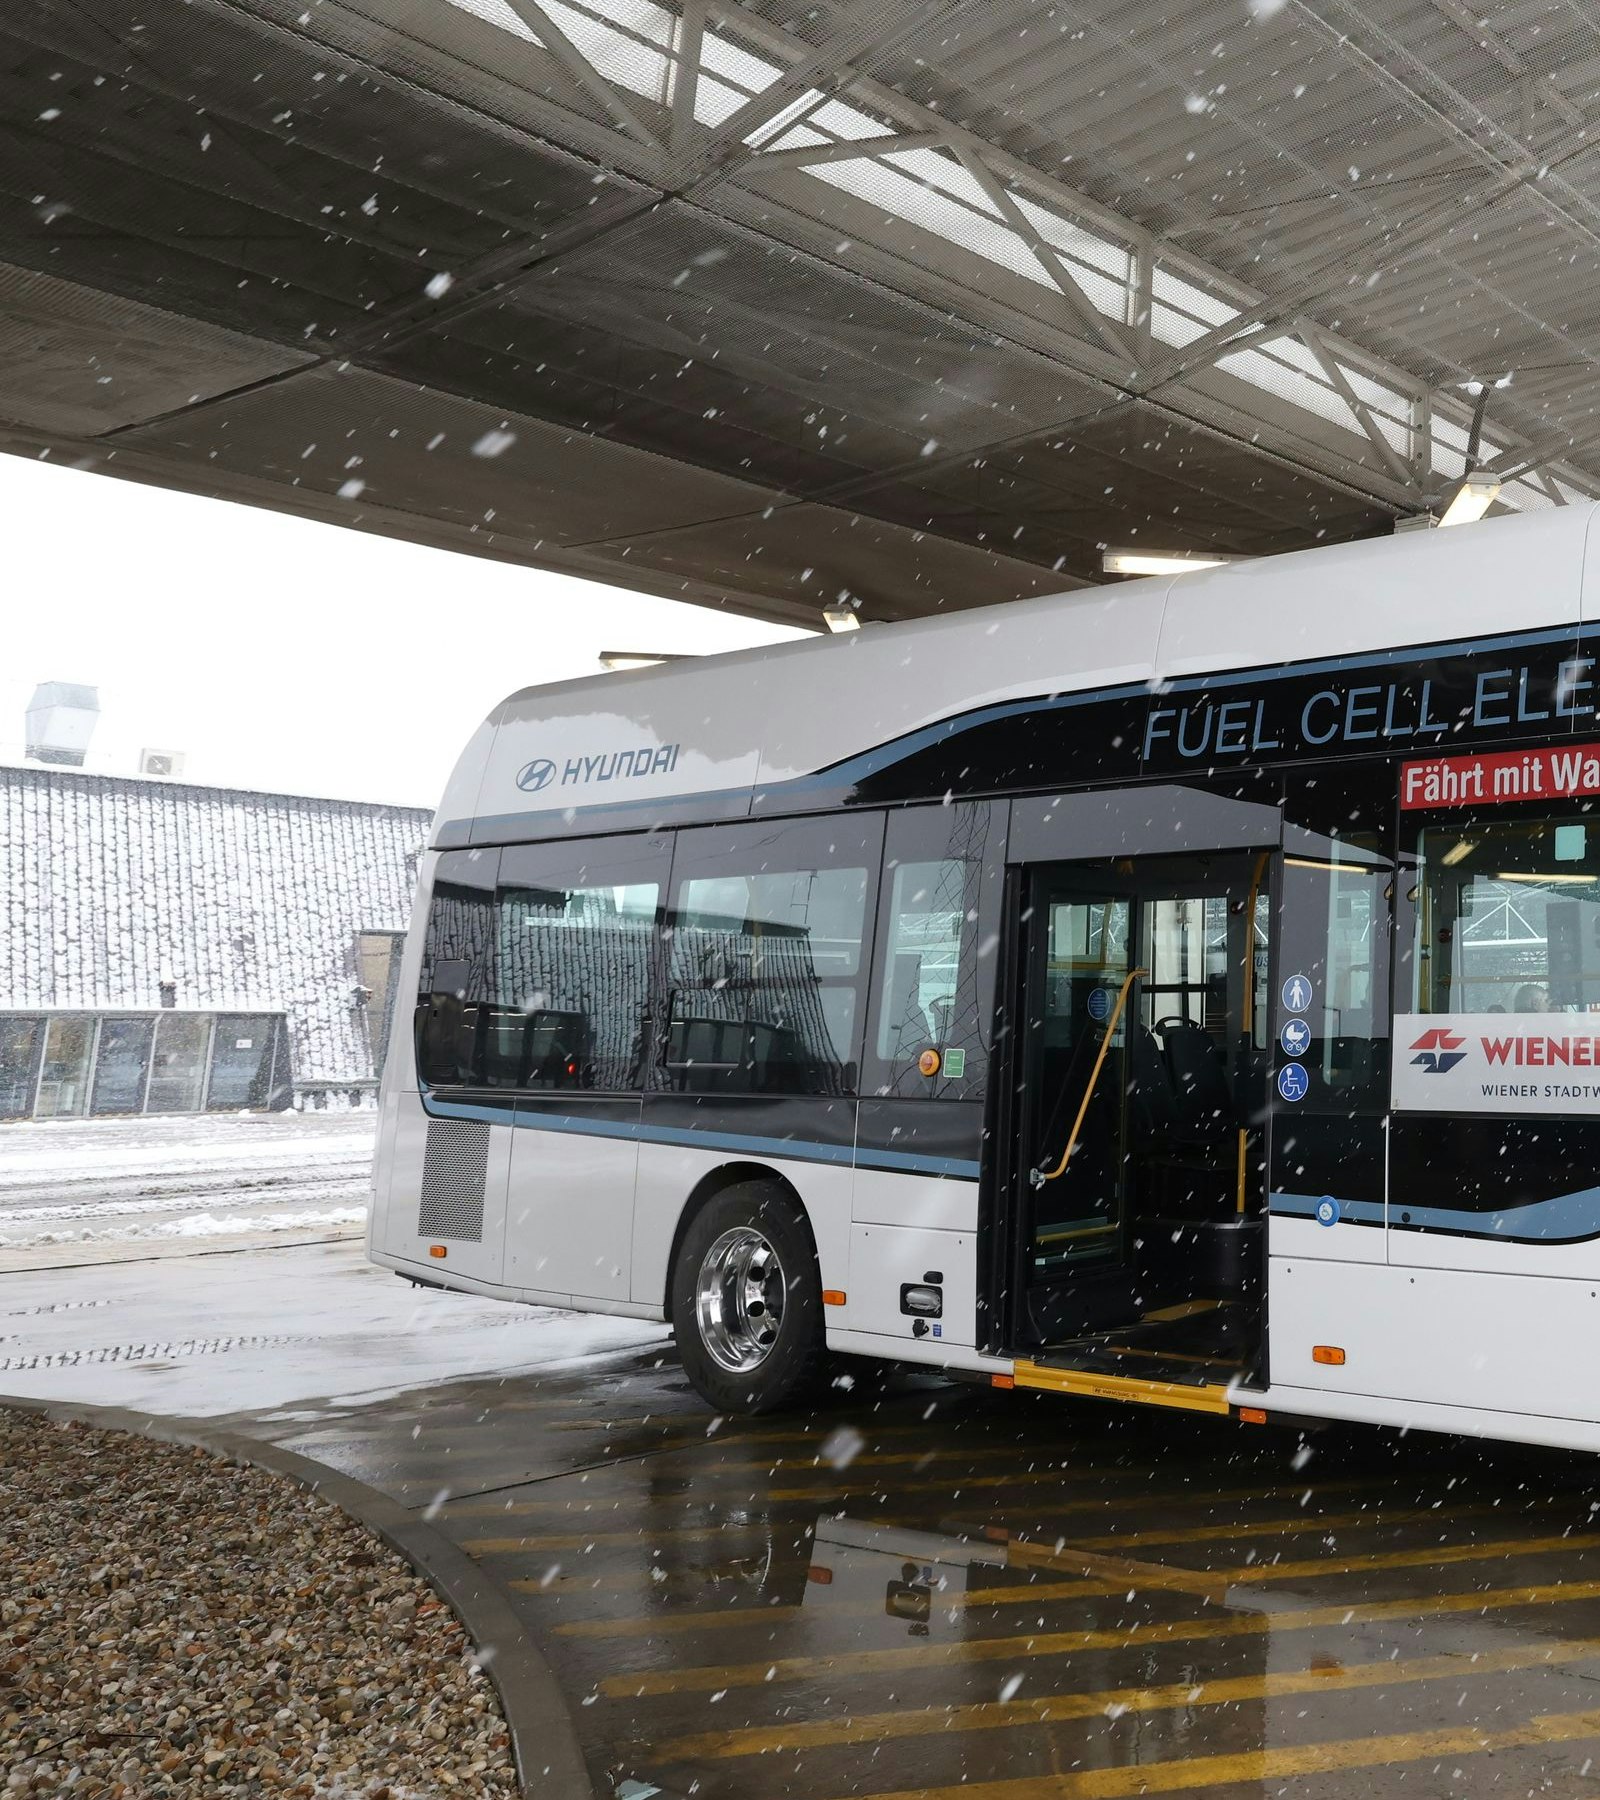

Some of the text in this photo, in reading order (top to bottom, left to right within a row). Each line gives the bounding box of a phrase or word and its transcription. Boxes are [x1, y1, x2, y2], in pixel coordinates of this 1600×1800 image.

[1142, 699, 1280, 761] FUEL
[1300, 679, 1449, 745] CELL
[560, 743, 681, 786] HYUNDAI
[1406, 761, 1484, 803] Fährt
[1493, 756, 1543, 796] mit
[1481, 1084, 1538, 1098] WIENER
